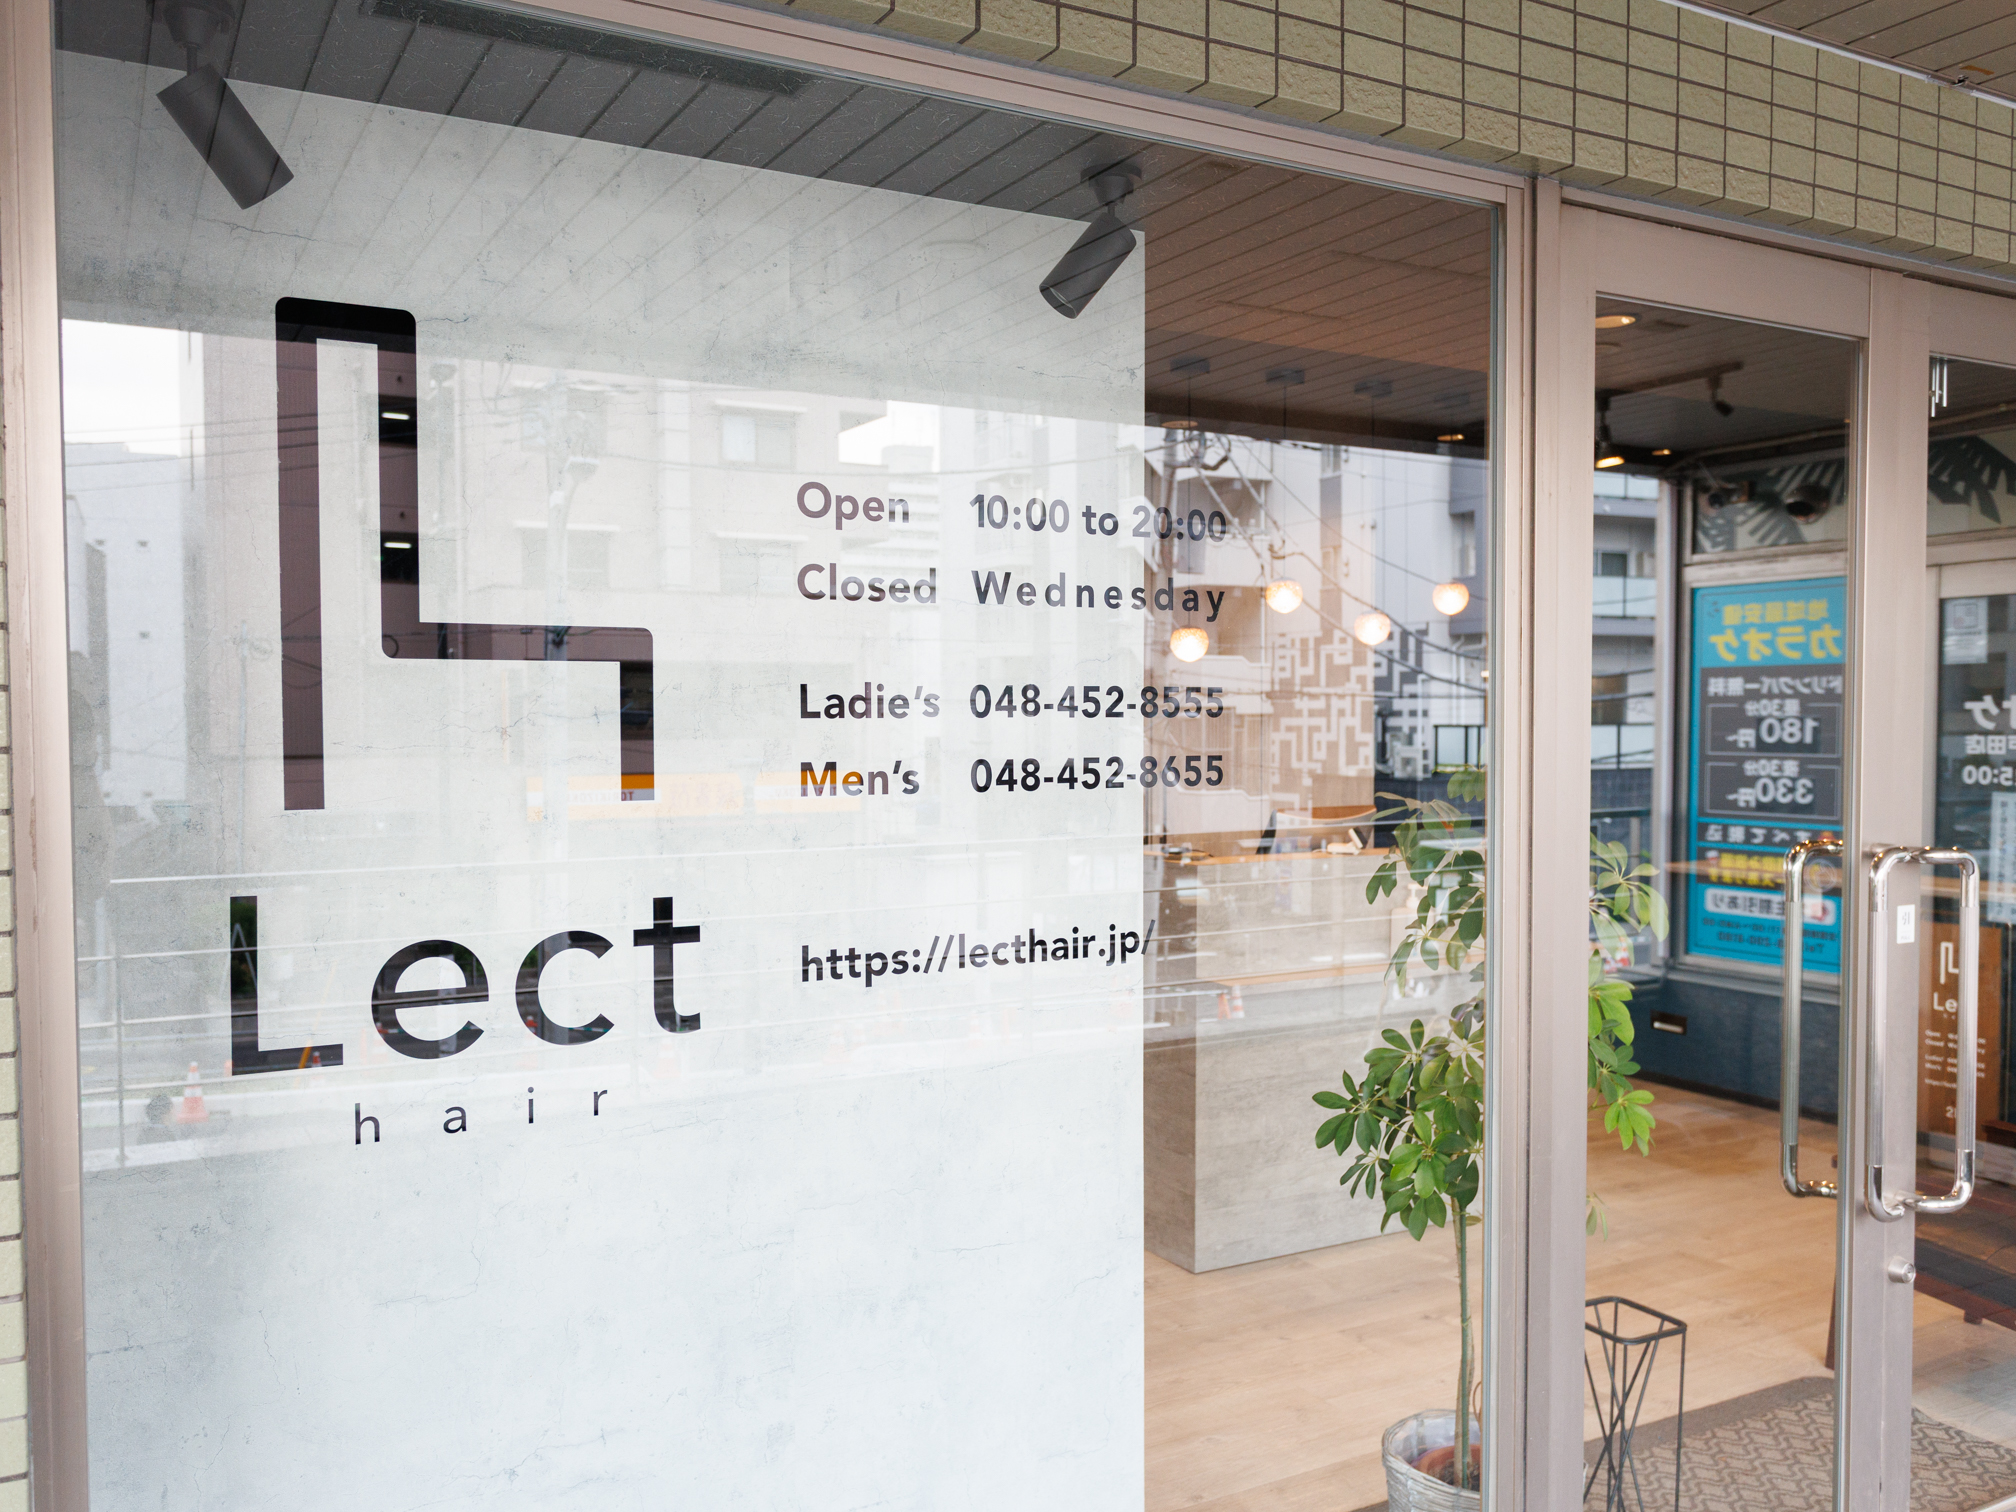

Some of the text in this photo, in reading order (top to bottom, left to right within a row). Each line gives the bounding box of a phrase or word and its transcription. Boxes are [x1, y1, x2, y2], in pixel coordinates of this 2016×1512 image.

[797, 481, 1227, 543] Open 10:00 to 20:00
[797, 562, 1226, 622] Closed Wednesday
[800, 681, 1224, 719] Ladie's 048-452-8555
[800, 755, 1224, 797] Men's 048-452-8655
[802, 919, 1155, 987] https://lecthair.jp/
[230, 895, 701, 1076] Lect
[1933, 992, 1958, 1012] Le
